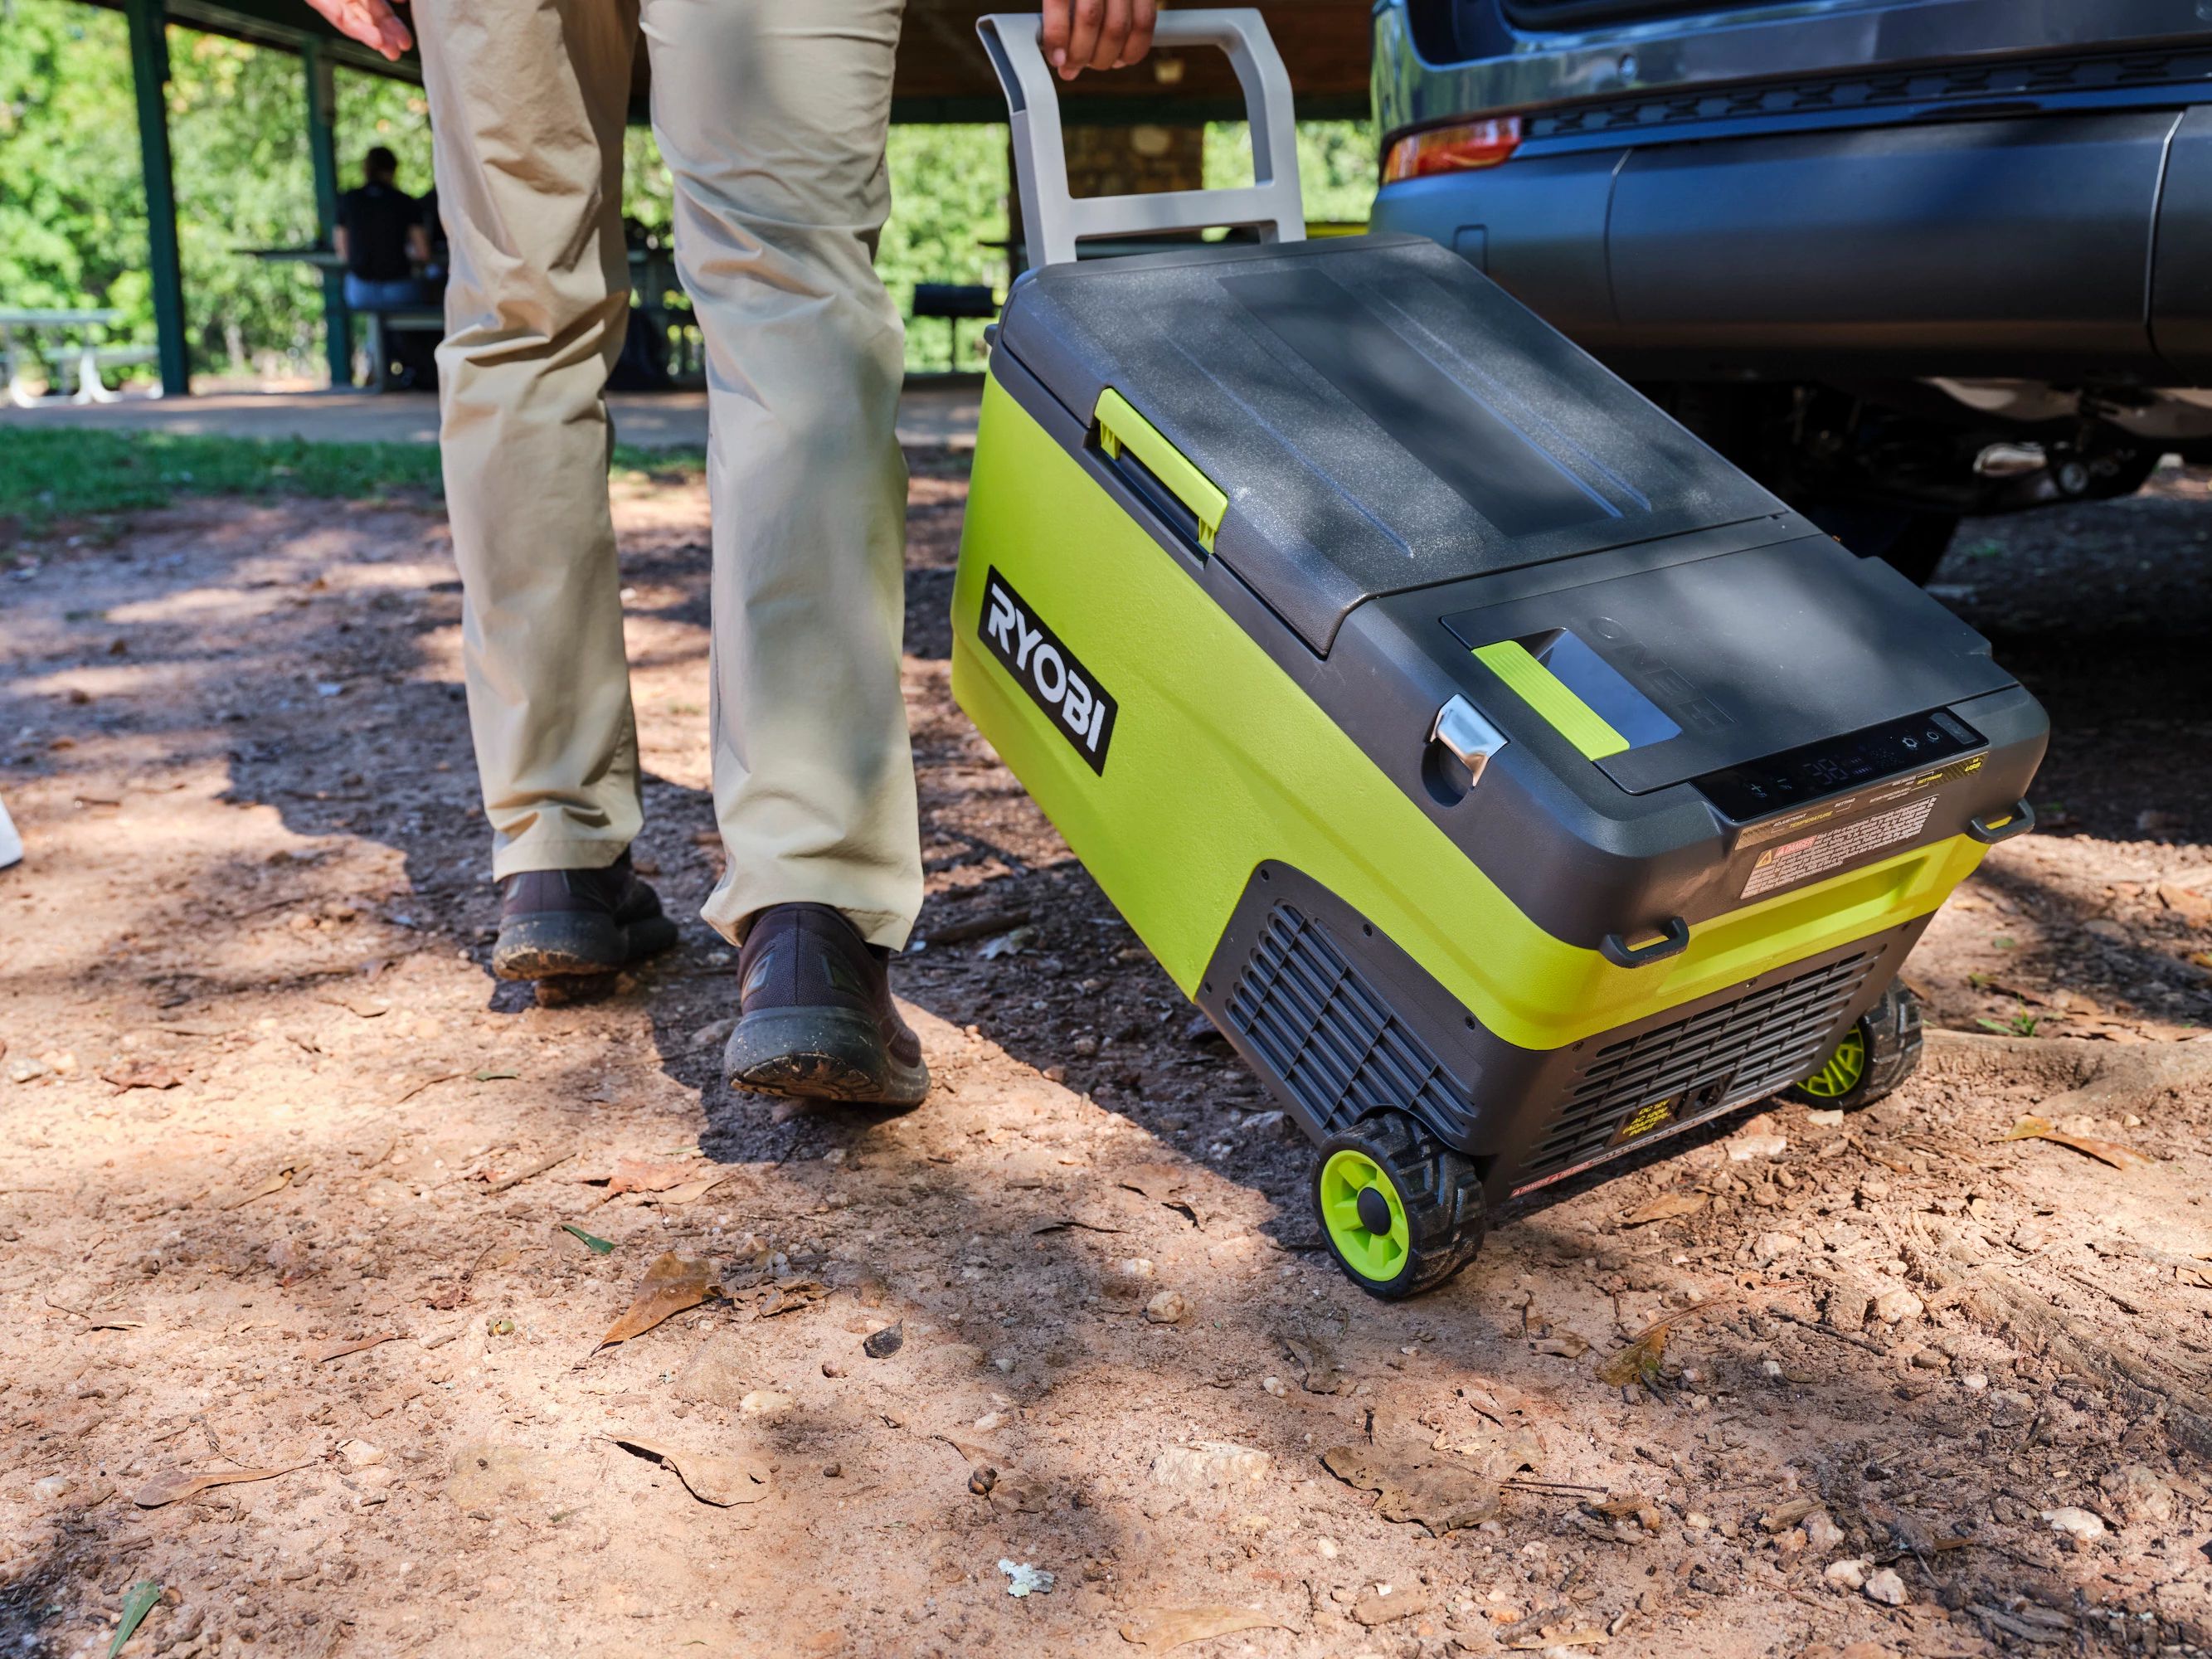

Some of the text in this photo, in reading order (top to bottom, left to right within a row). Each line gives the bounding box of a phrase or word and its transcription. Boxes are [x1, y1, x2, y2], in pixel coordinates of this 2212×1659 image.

[988, 582, 1106, 752] RYOBI
[1965, 761, 1981, 771] USB
[1789, 810, 1834, 829] TEMPERATURE
[1785, 837, 1814, 854] DANGER
[1631, 1115, 1646, 1125] AC
[1629, 1121, 1656, 1136] INPUT
